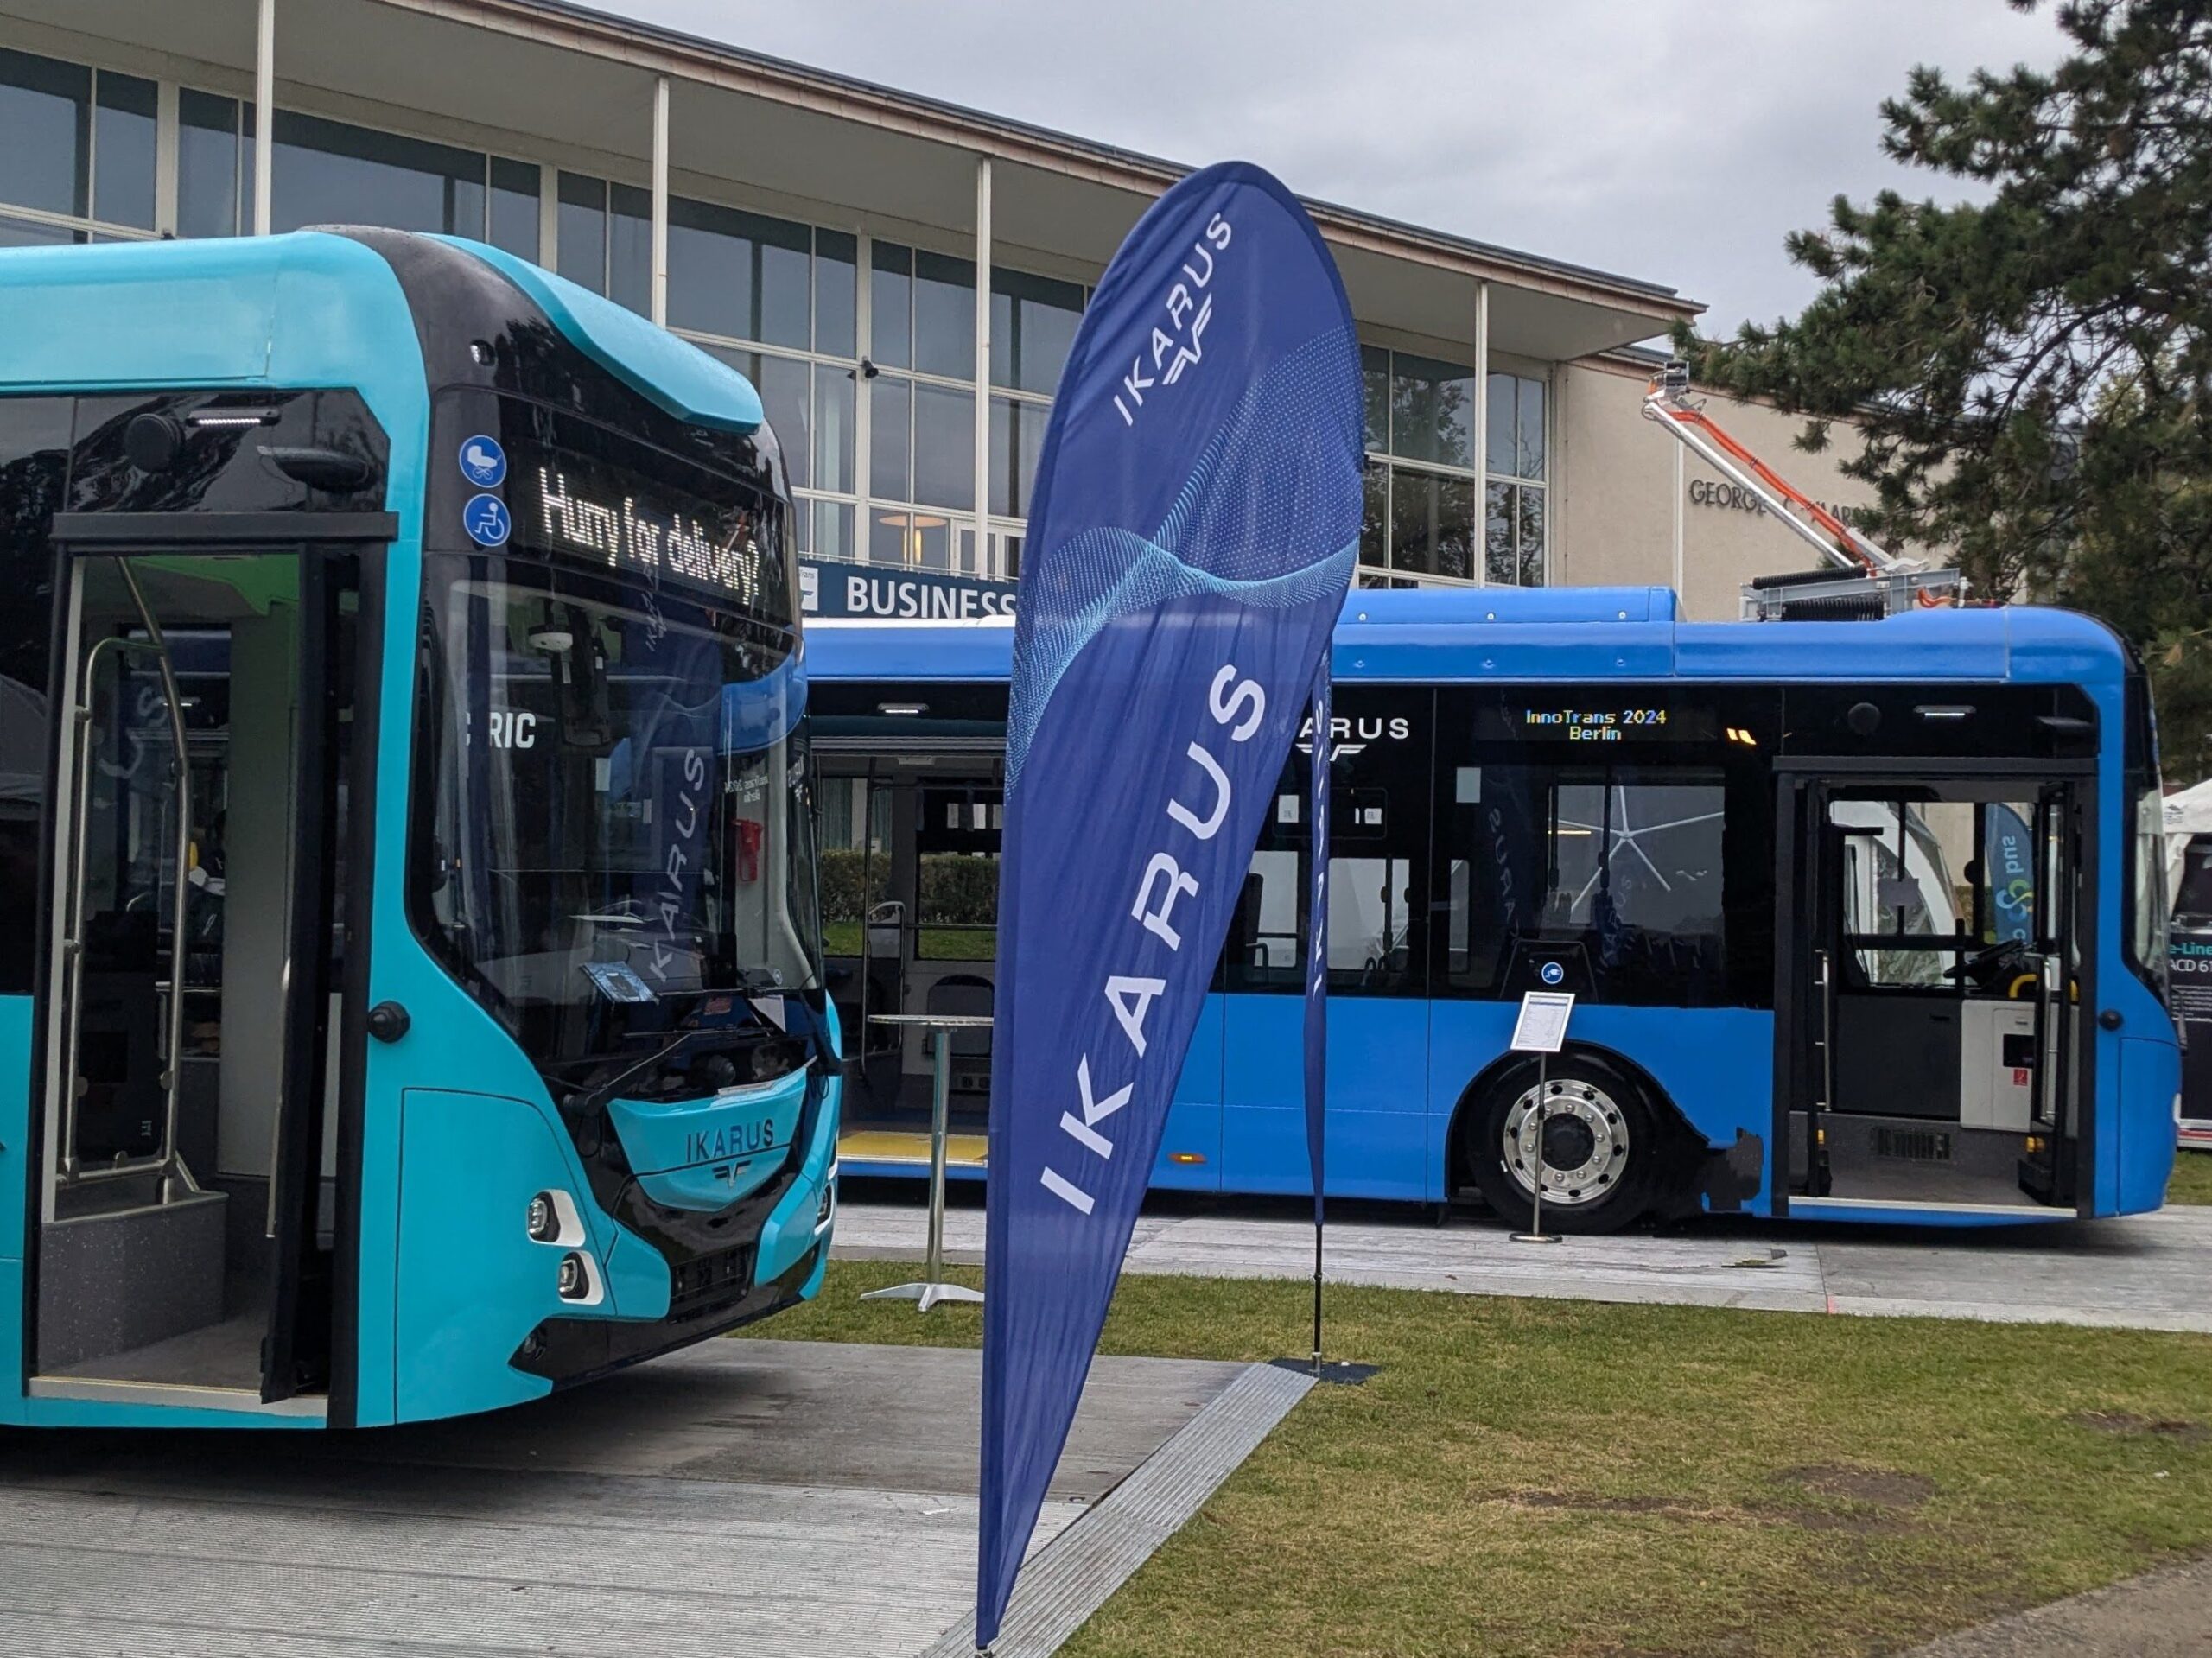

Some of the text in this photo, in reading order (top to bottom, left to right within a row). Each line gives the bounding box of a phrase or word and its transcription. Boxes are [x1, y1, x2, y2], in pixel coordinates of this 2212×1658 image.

[1114, 213, 1232, 426] IKARUS
[539, 467, 620, 567] Hurry
[625, 497, 660, 565] for
[848, 576, 1017, 619] BUSINESS
[467, 712, 536, 748] RIC
[1526, 709, 1667, 724] InnoTrans 2024
[1569, 726, 1622, 740] Berlin
[1039, 664, 1267, 1216] IKARUS
[687, 1119, 774, 1163] IKARUS
